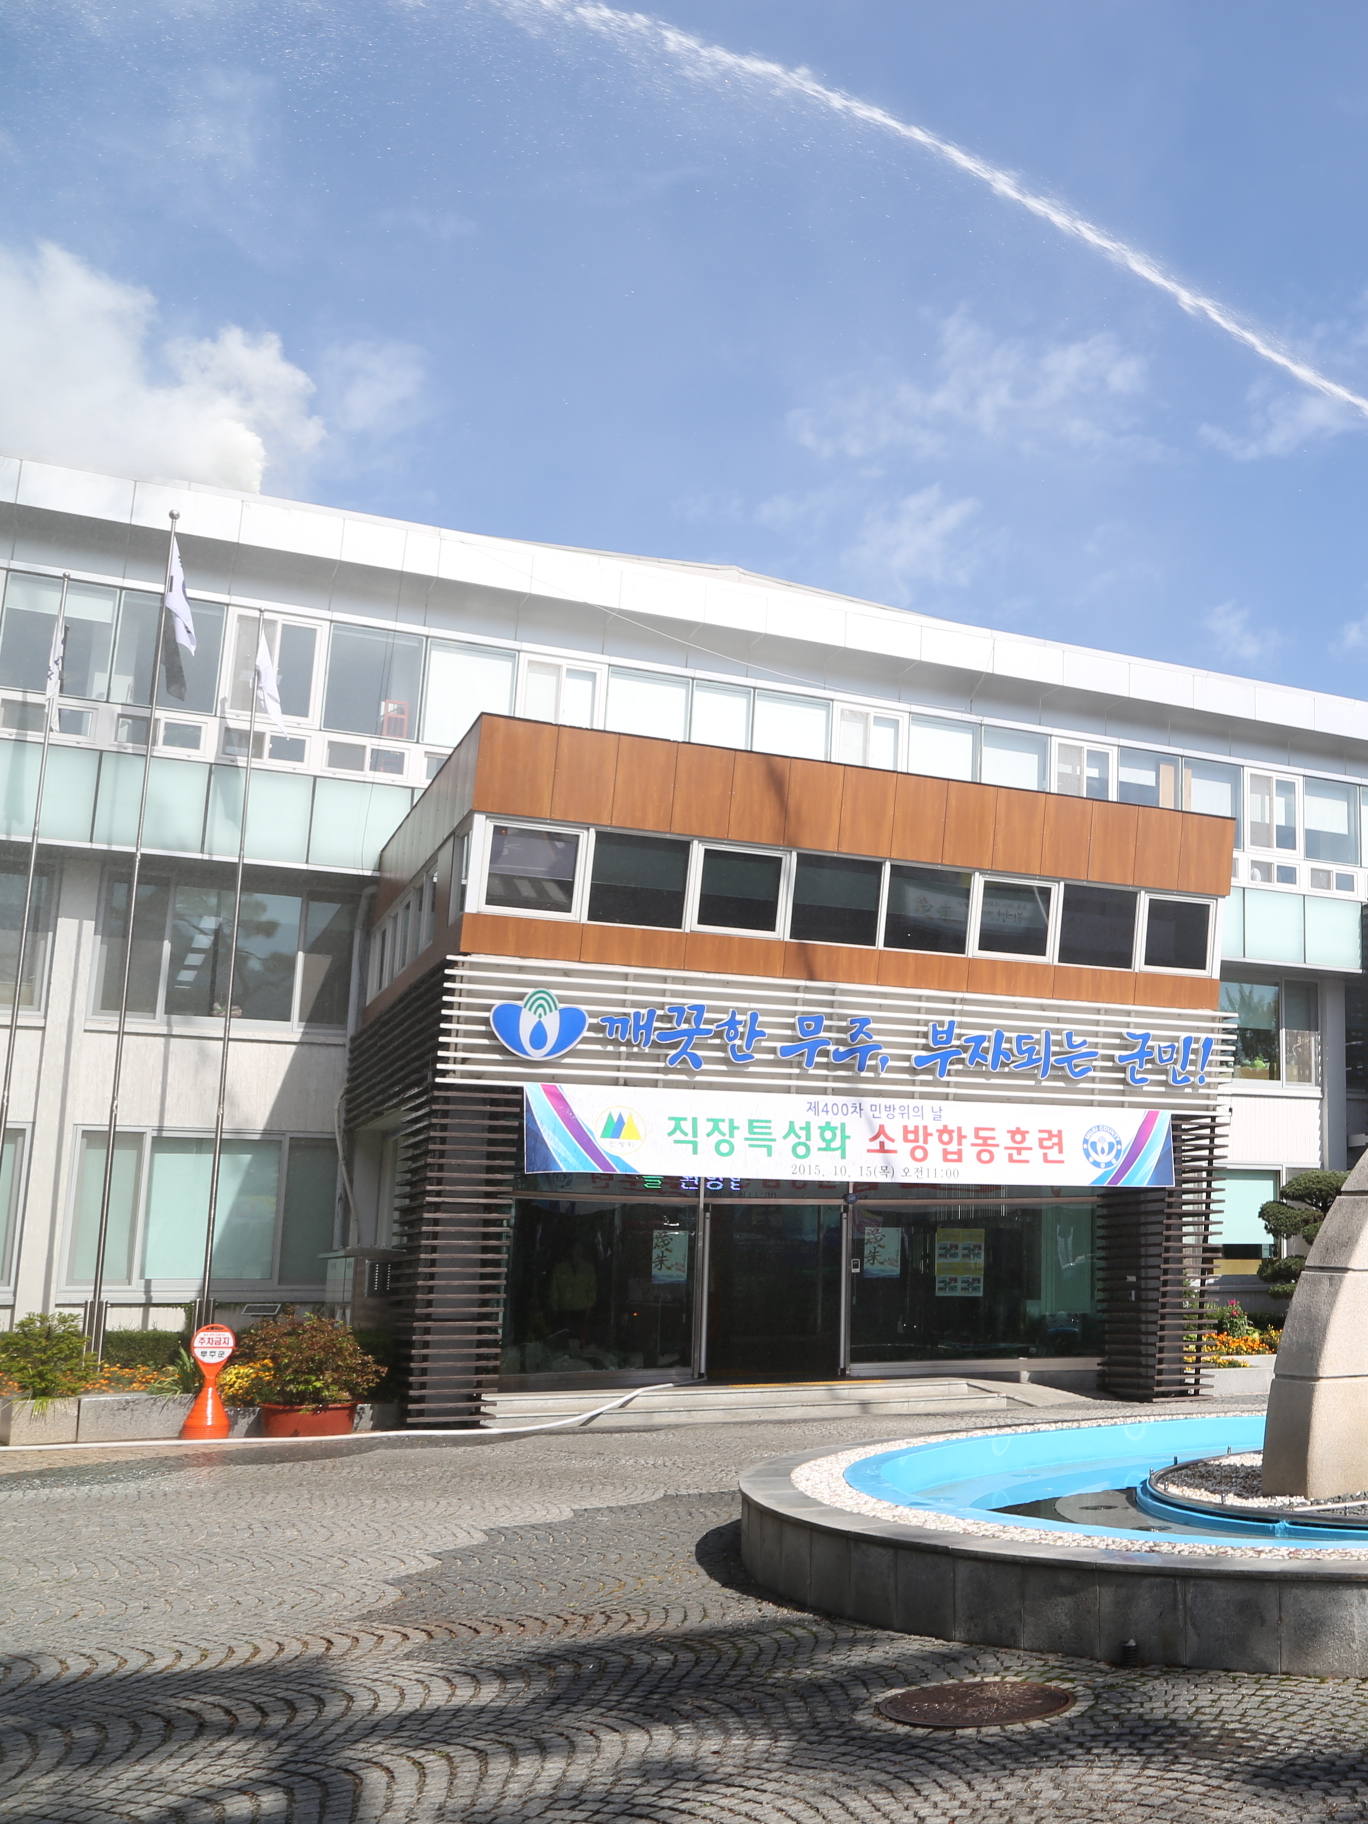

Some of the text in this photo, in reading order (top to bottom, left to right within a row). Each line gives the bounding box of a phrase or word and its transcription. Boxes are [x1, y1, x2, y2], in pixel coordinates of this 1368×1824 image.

[598, 1003, 1213, 1087] 깨끗한 무주, 부자되는 군민!
[806, 1101, 943, 1122] 제400차 민방위의 날
[666, 1116, 1066, 1165] 직장특성화 소방합동훈련
[791, 1164, 961, 1180] 2015. 10. 15(목) 오전11:00
[198, 1336, 230, 1346] 주차금지
